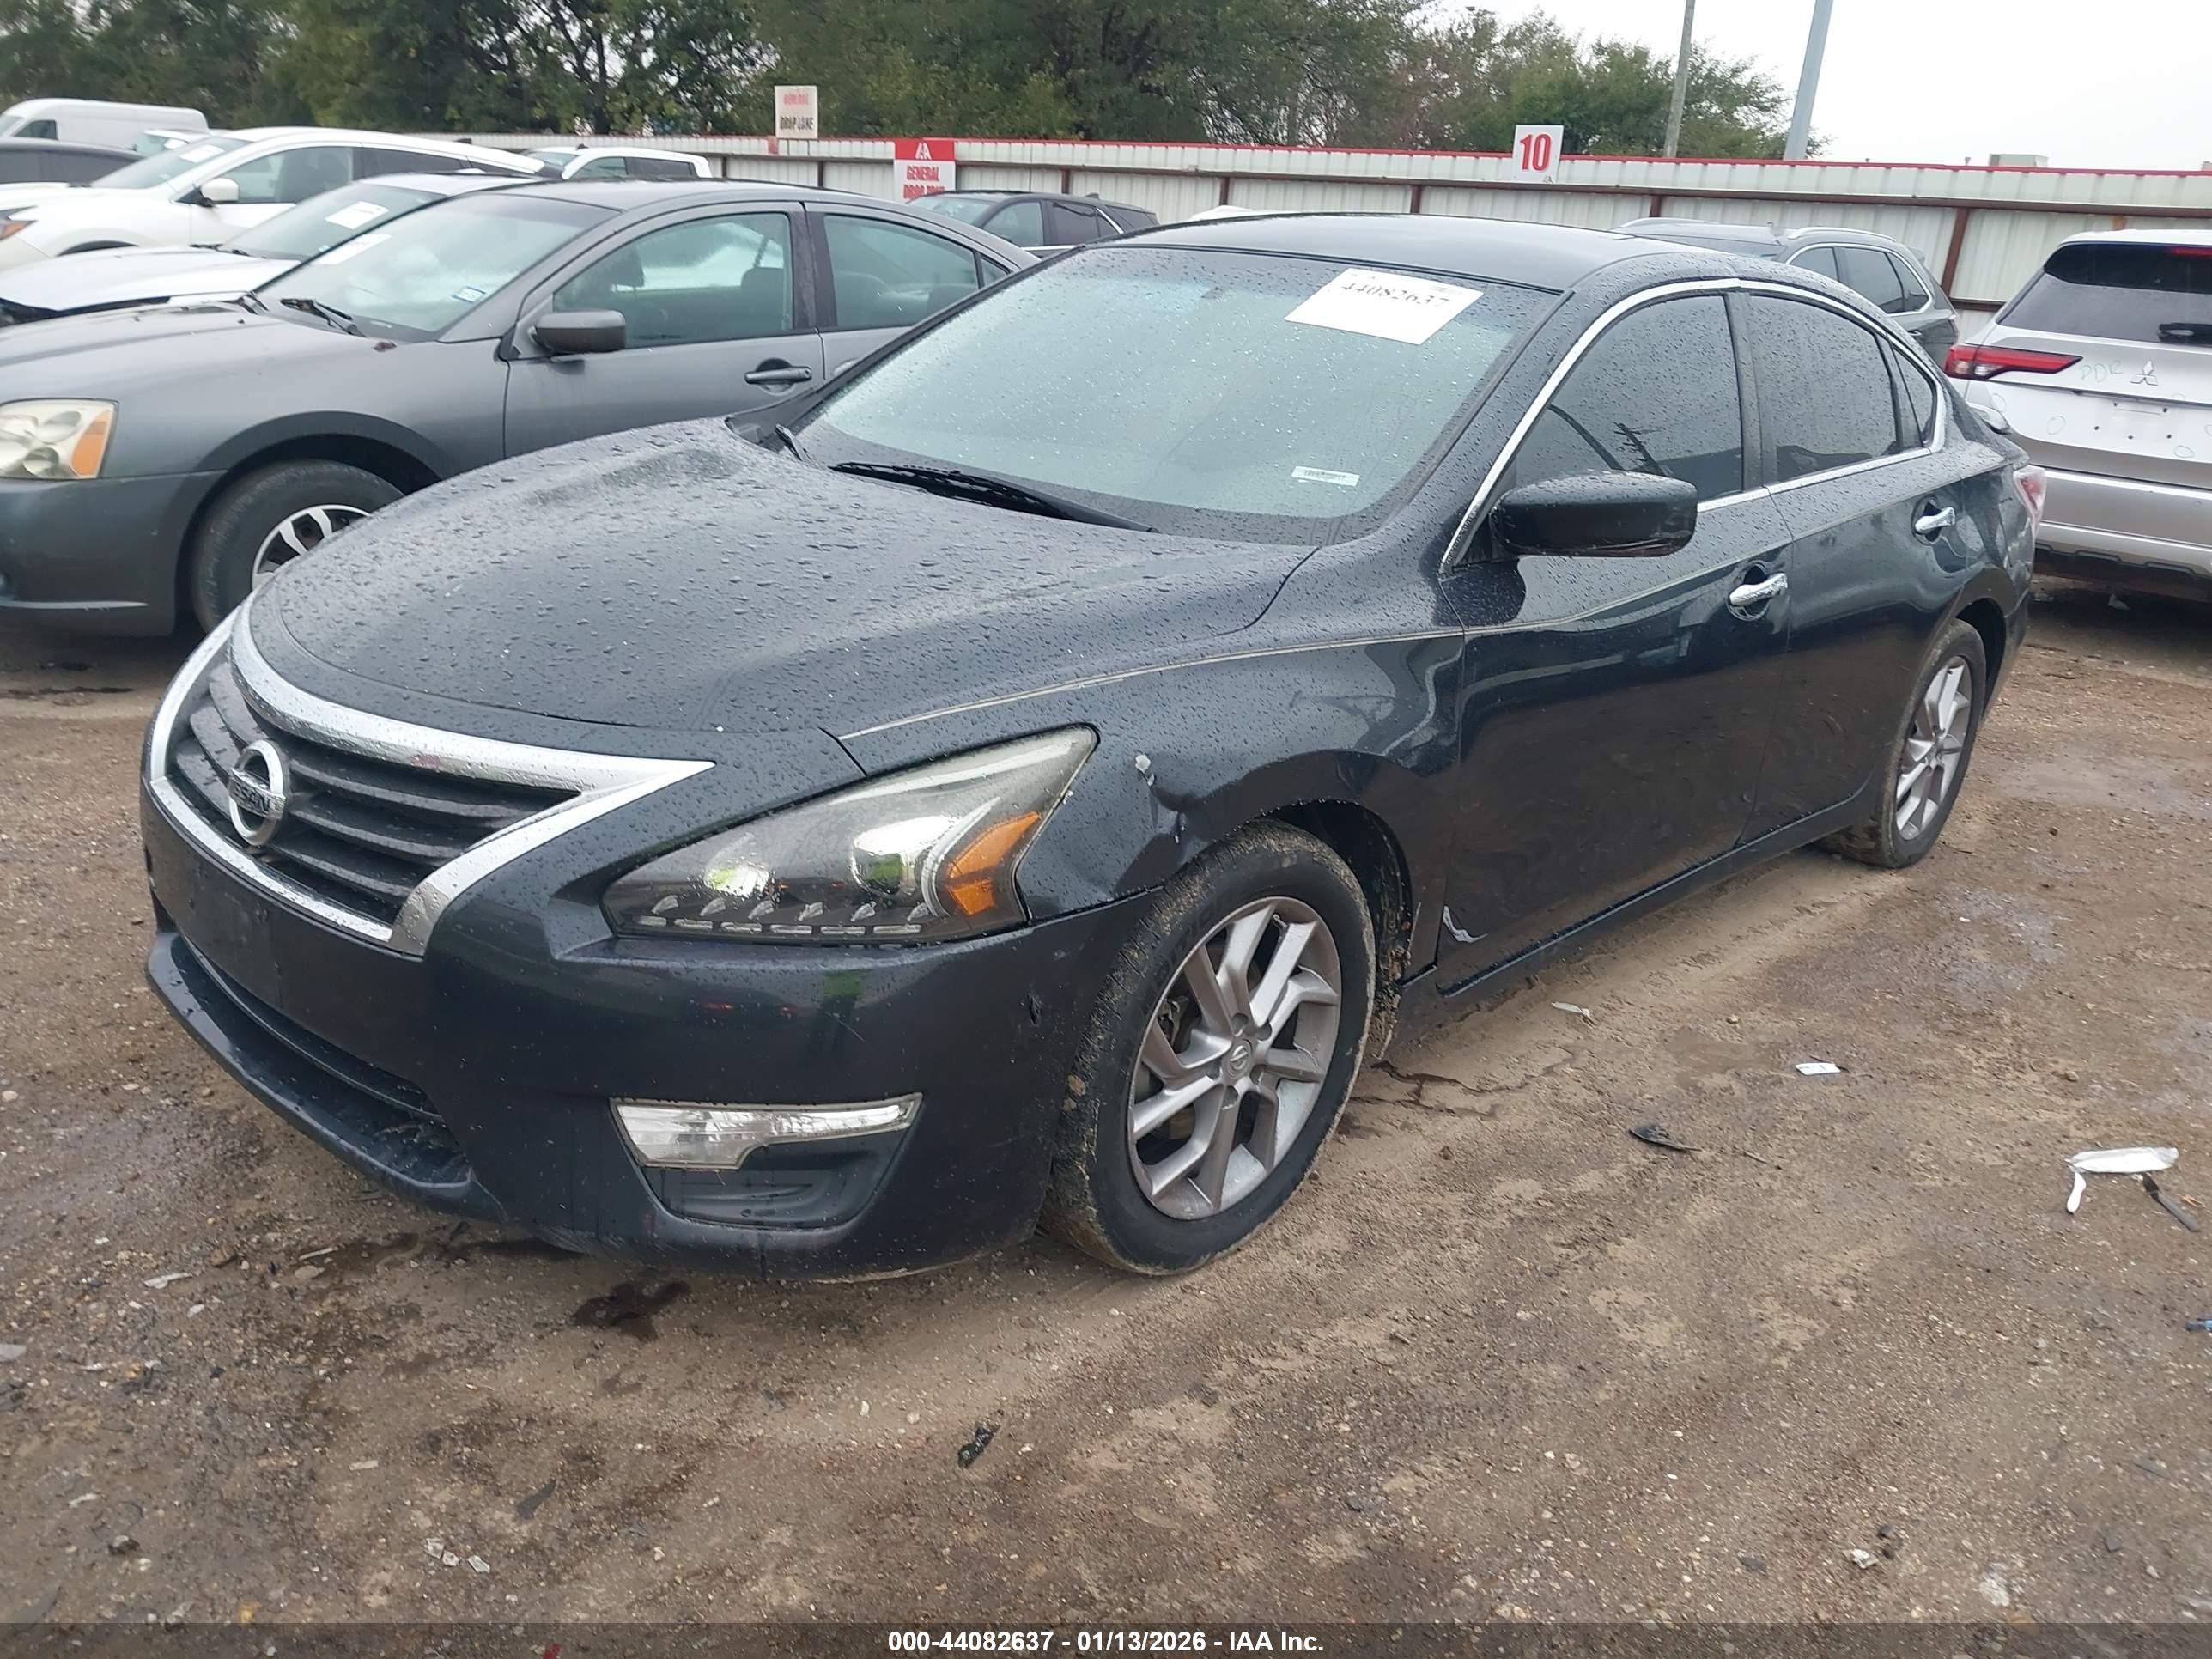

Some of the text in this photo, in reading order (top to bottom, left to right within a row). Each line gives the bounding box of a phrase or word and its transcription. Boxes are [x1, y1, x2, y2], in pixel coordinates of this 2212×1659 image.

[1520, 133, 1551, 171] 10
[907, 165, 940, 181] GENERAL
[903, 184, 925, 199] DROP
[1340, 282, 1451, 308] 44082637
